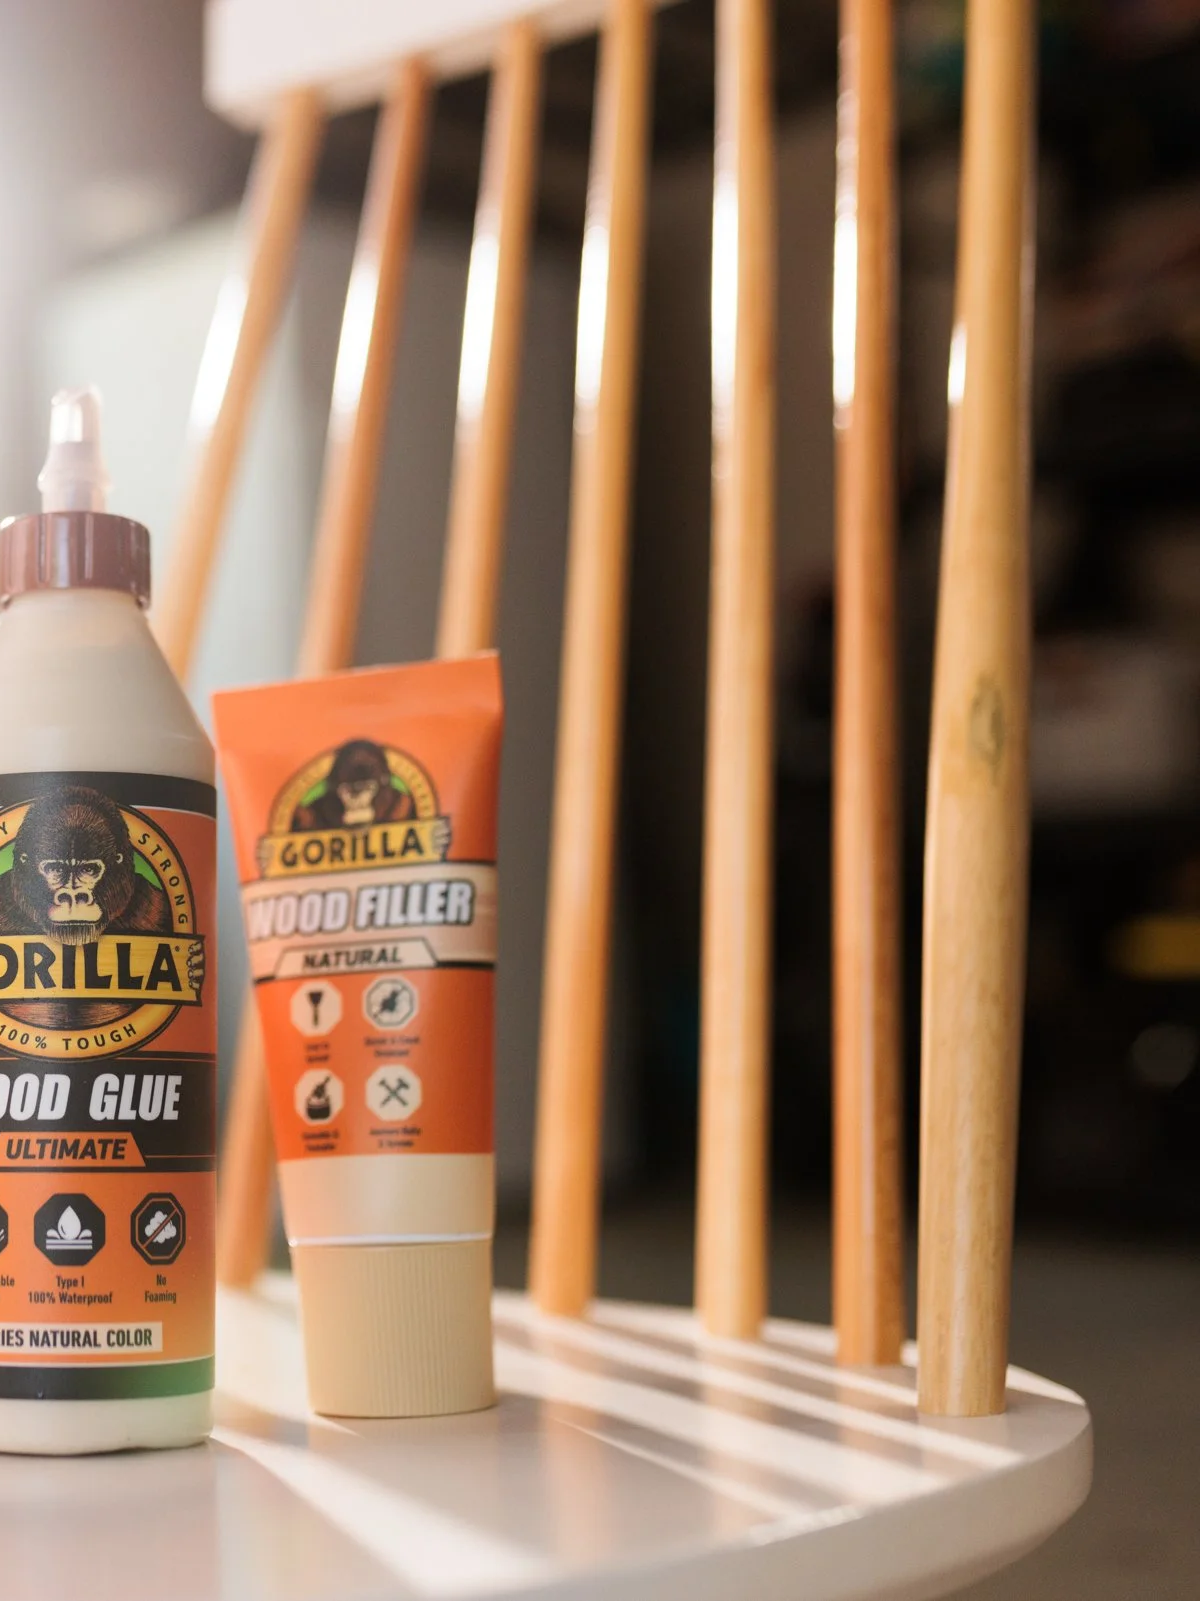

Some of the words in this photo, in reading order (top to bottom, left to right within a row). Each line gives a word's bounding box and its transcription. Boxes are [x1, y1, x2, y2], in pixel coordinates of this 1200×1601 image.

[281, 828, 424, 867] GORILLA
[138, 832, 189, 925] STRONG
[250, 889, 350, 940] WOOD
[354, 880, 475, 927] FILLER
[302, 946, 402, 970] NATURAL
[62, 1023, 138, 1051] TOUGH
[89, 1073, 184, 1121] GLUE
[6, 1138, 128, 1160] ULTIMATE
[56, 1275, 78, 1289] Type
[156, 1274, 167, 1286] No
[28, 1291, 56, 1304] 100%
[59, 1291, 113, 1306] Waterproof
[144, 1290, 177, 1305] Foaming
[29, 1329, 102, 1348] NATURAL
[106, 1328, 152, 1347] COLOR
